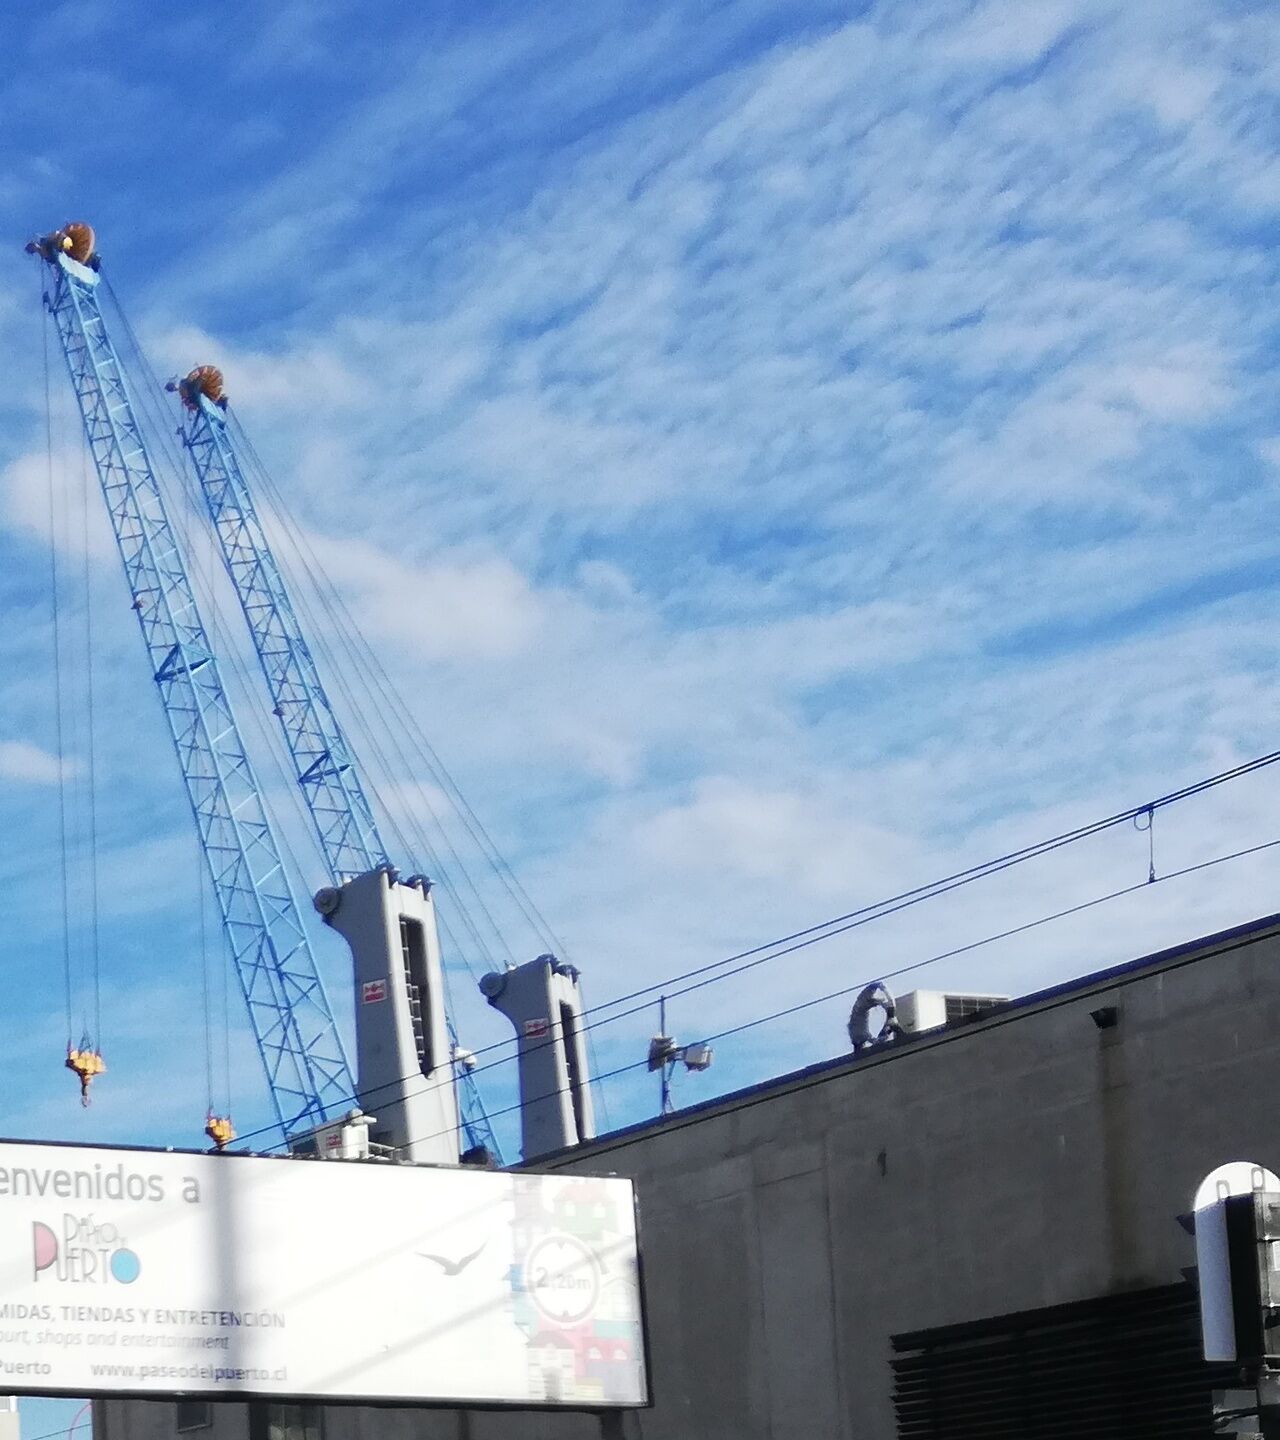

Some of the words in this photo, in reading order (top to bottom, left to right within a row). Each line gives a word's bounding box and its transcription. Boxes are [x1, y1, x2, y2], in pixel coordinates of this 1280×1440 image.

[182, 1175, 201, 1204] a
[32, 1220, 142, 1285] PUERTO
[61, 1306, 135, 1323] TIENDAS
[140, 1309, 150, 1324] Y
[156, 1308, 286, 1328] ENTRETENCIÓN
[37, 1328, 82, 1349] shops
[90, 1362, 288, 1383] www.paseodelpuerto.cl
